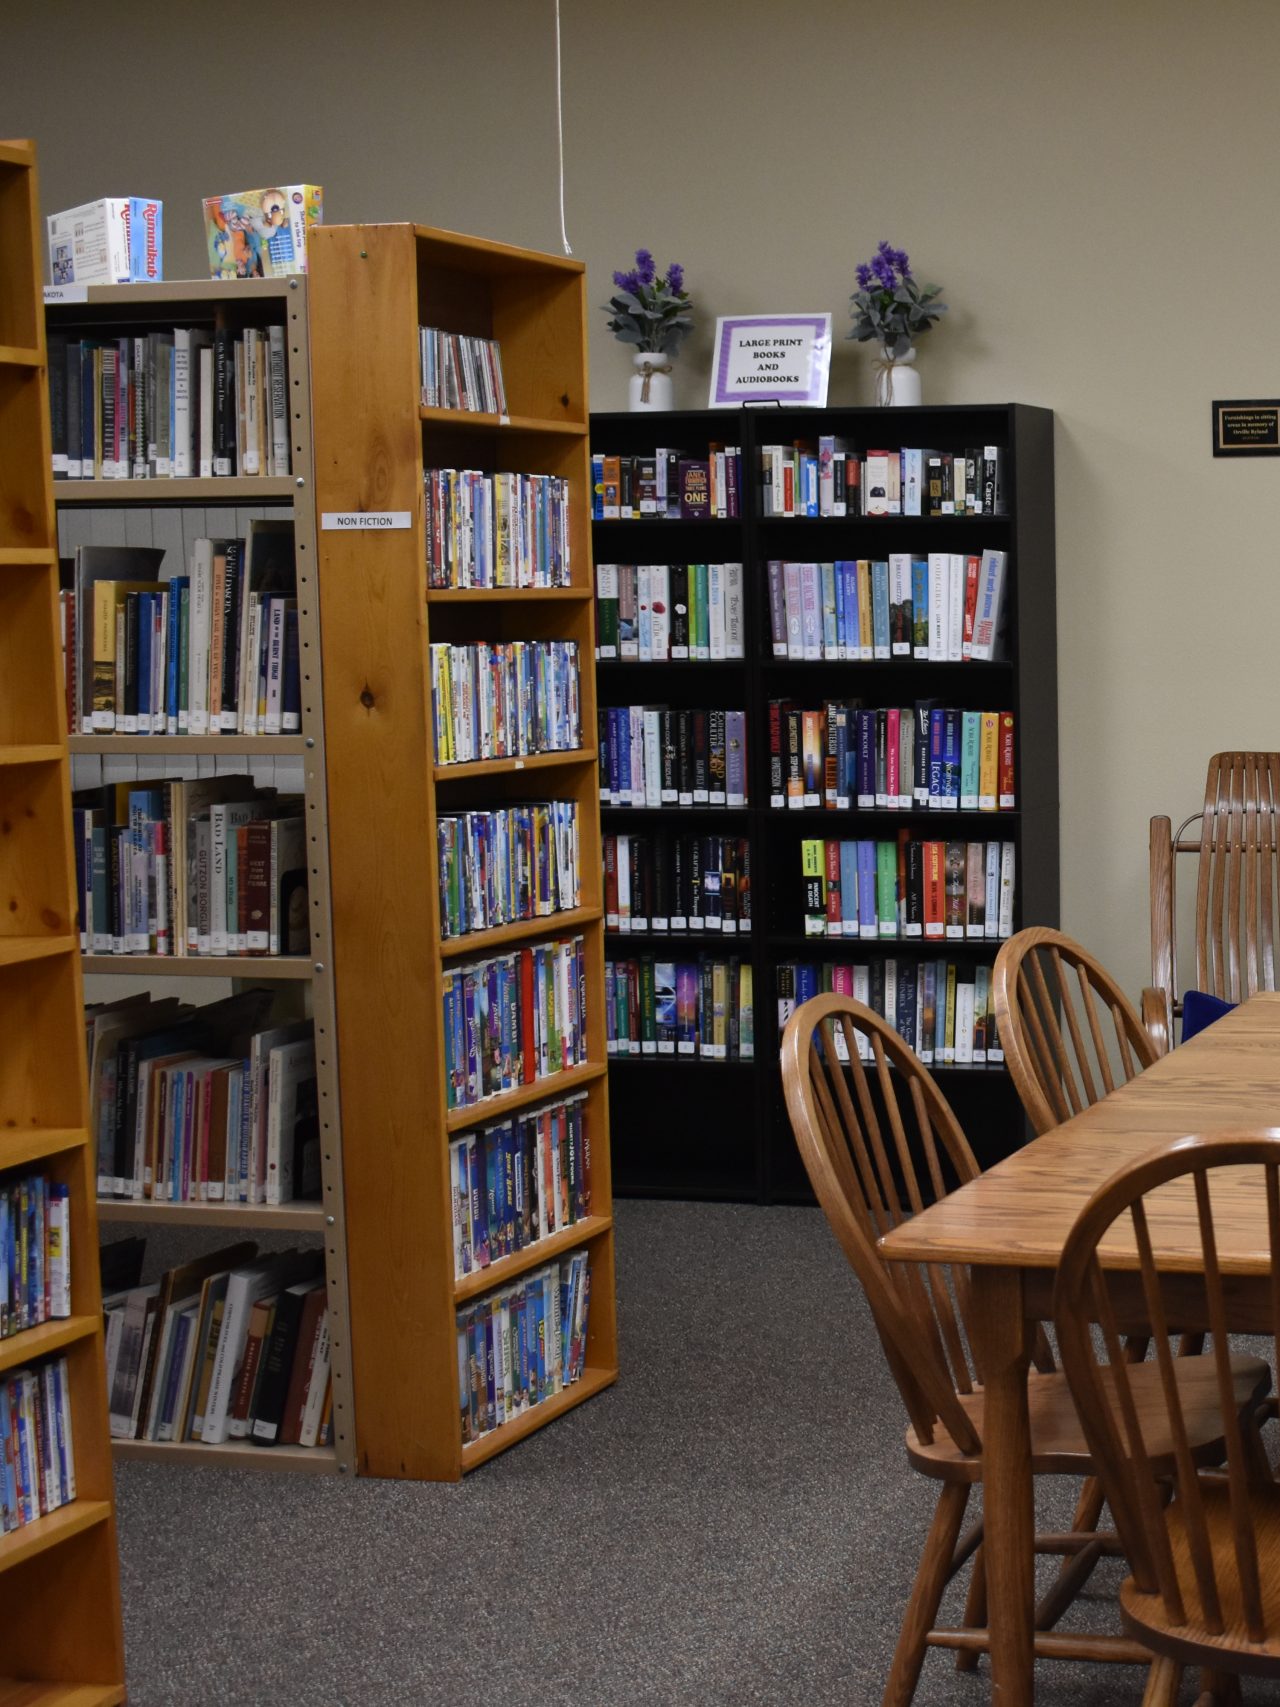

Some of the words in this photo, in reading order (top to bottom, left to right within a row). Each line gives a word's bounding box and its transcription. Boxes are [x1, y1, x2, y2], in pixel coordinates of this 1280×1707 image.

[143, 203, 158, 278] Rummikub
[739, 339, 771, 347] LARGE
[753, 351, 786, 359] BOOKS
[217, 354, 225, 371] What
[271, 350, 284, 379] WITHOUT
[757, 363, 779, 371] AND
[736, 375, 799, 384] AUDIOBOOKS
[272, 380, 285, 420] RESERVATION
[684, 492, 708, 502] ONE
[985, 482, 994, 506] Caste
[337, 517, 362, 526] NON
[364, 517, 393, 526] FICTION
[272, 609, 281, 625] LAND
[828, 704, 837, 722] JAMES
[710, 712, 718, 747] COULTER
[828, 723, 837, 755] PATTERSON
[931, 761, 942, 796] LEGACY
[215, 812, 224, 837] BAD
[215, 841, 224, 874] LAND
[199, 850, 208, 890] GUTZON
